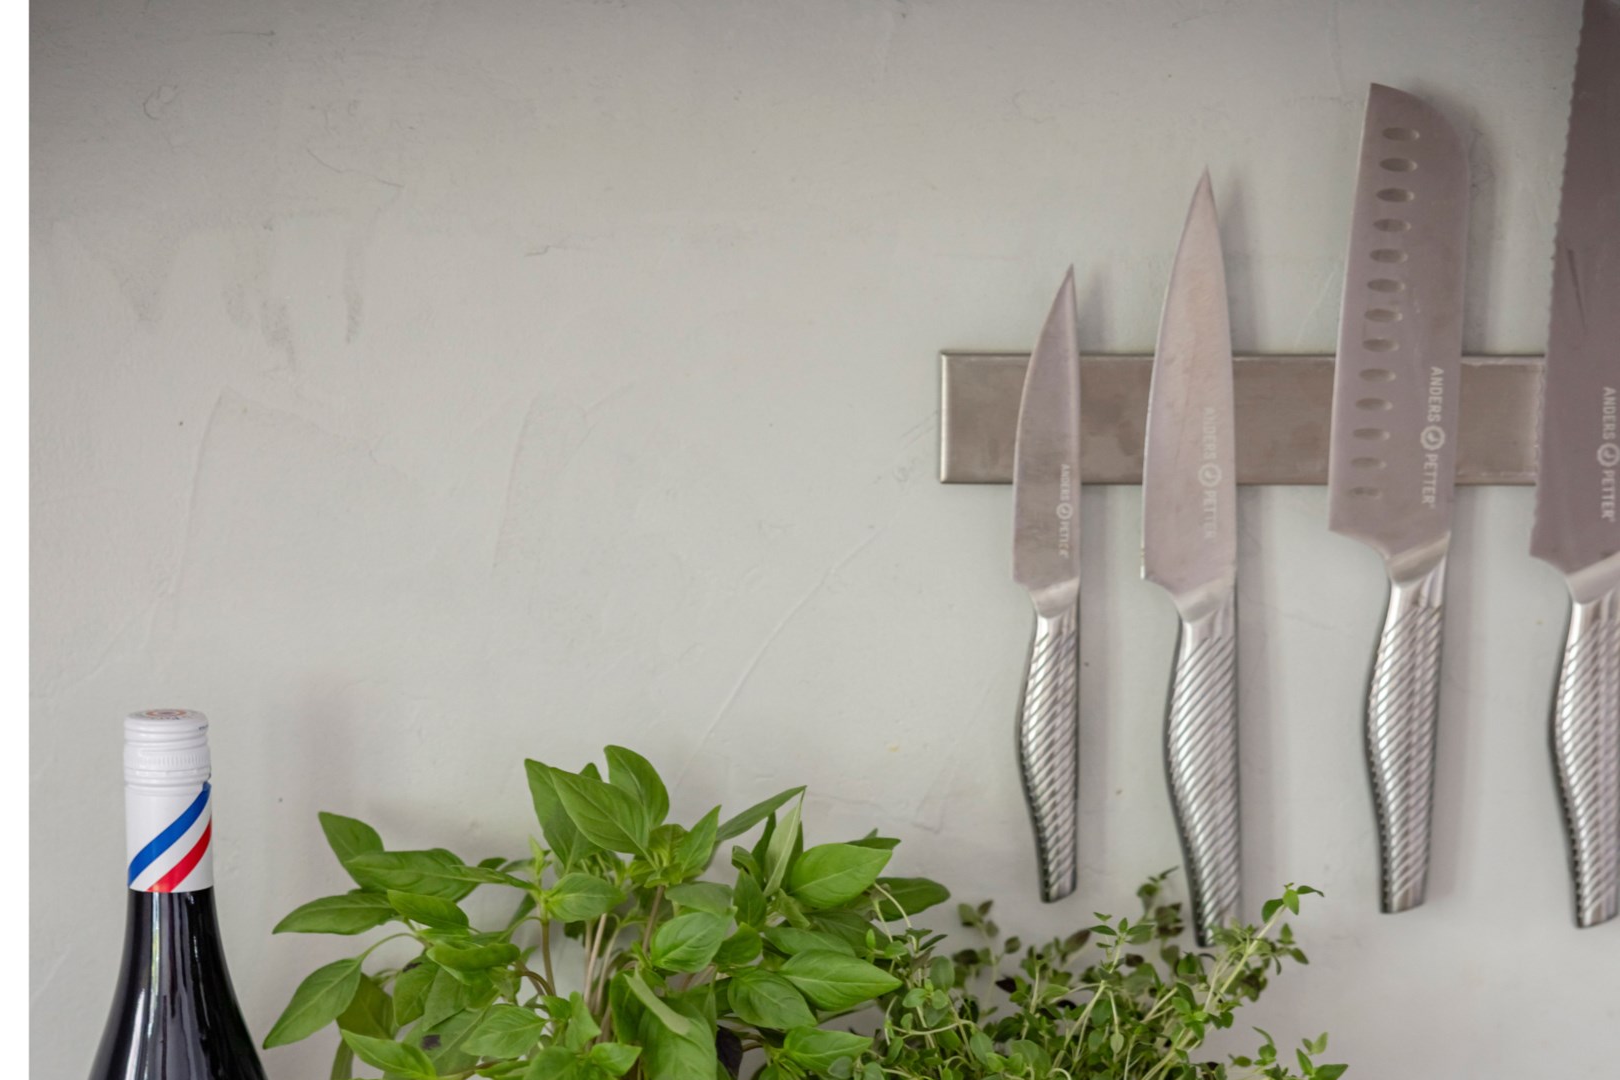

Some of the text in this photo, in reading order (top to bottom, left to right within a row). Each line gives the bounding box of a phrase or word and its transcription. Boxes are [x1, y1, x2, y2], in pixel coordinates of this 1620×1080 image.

[1060, 464, 1070, 501] ANDERS
[1203, 407, 1217, 540] ANDERS PETTER
[1422, 366, 1444, 505] ANDERS PETTER
[1601, 387, 1616, 520] ANDERS PETTER
